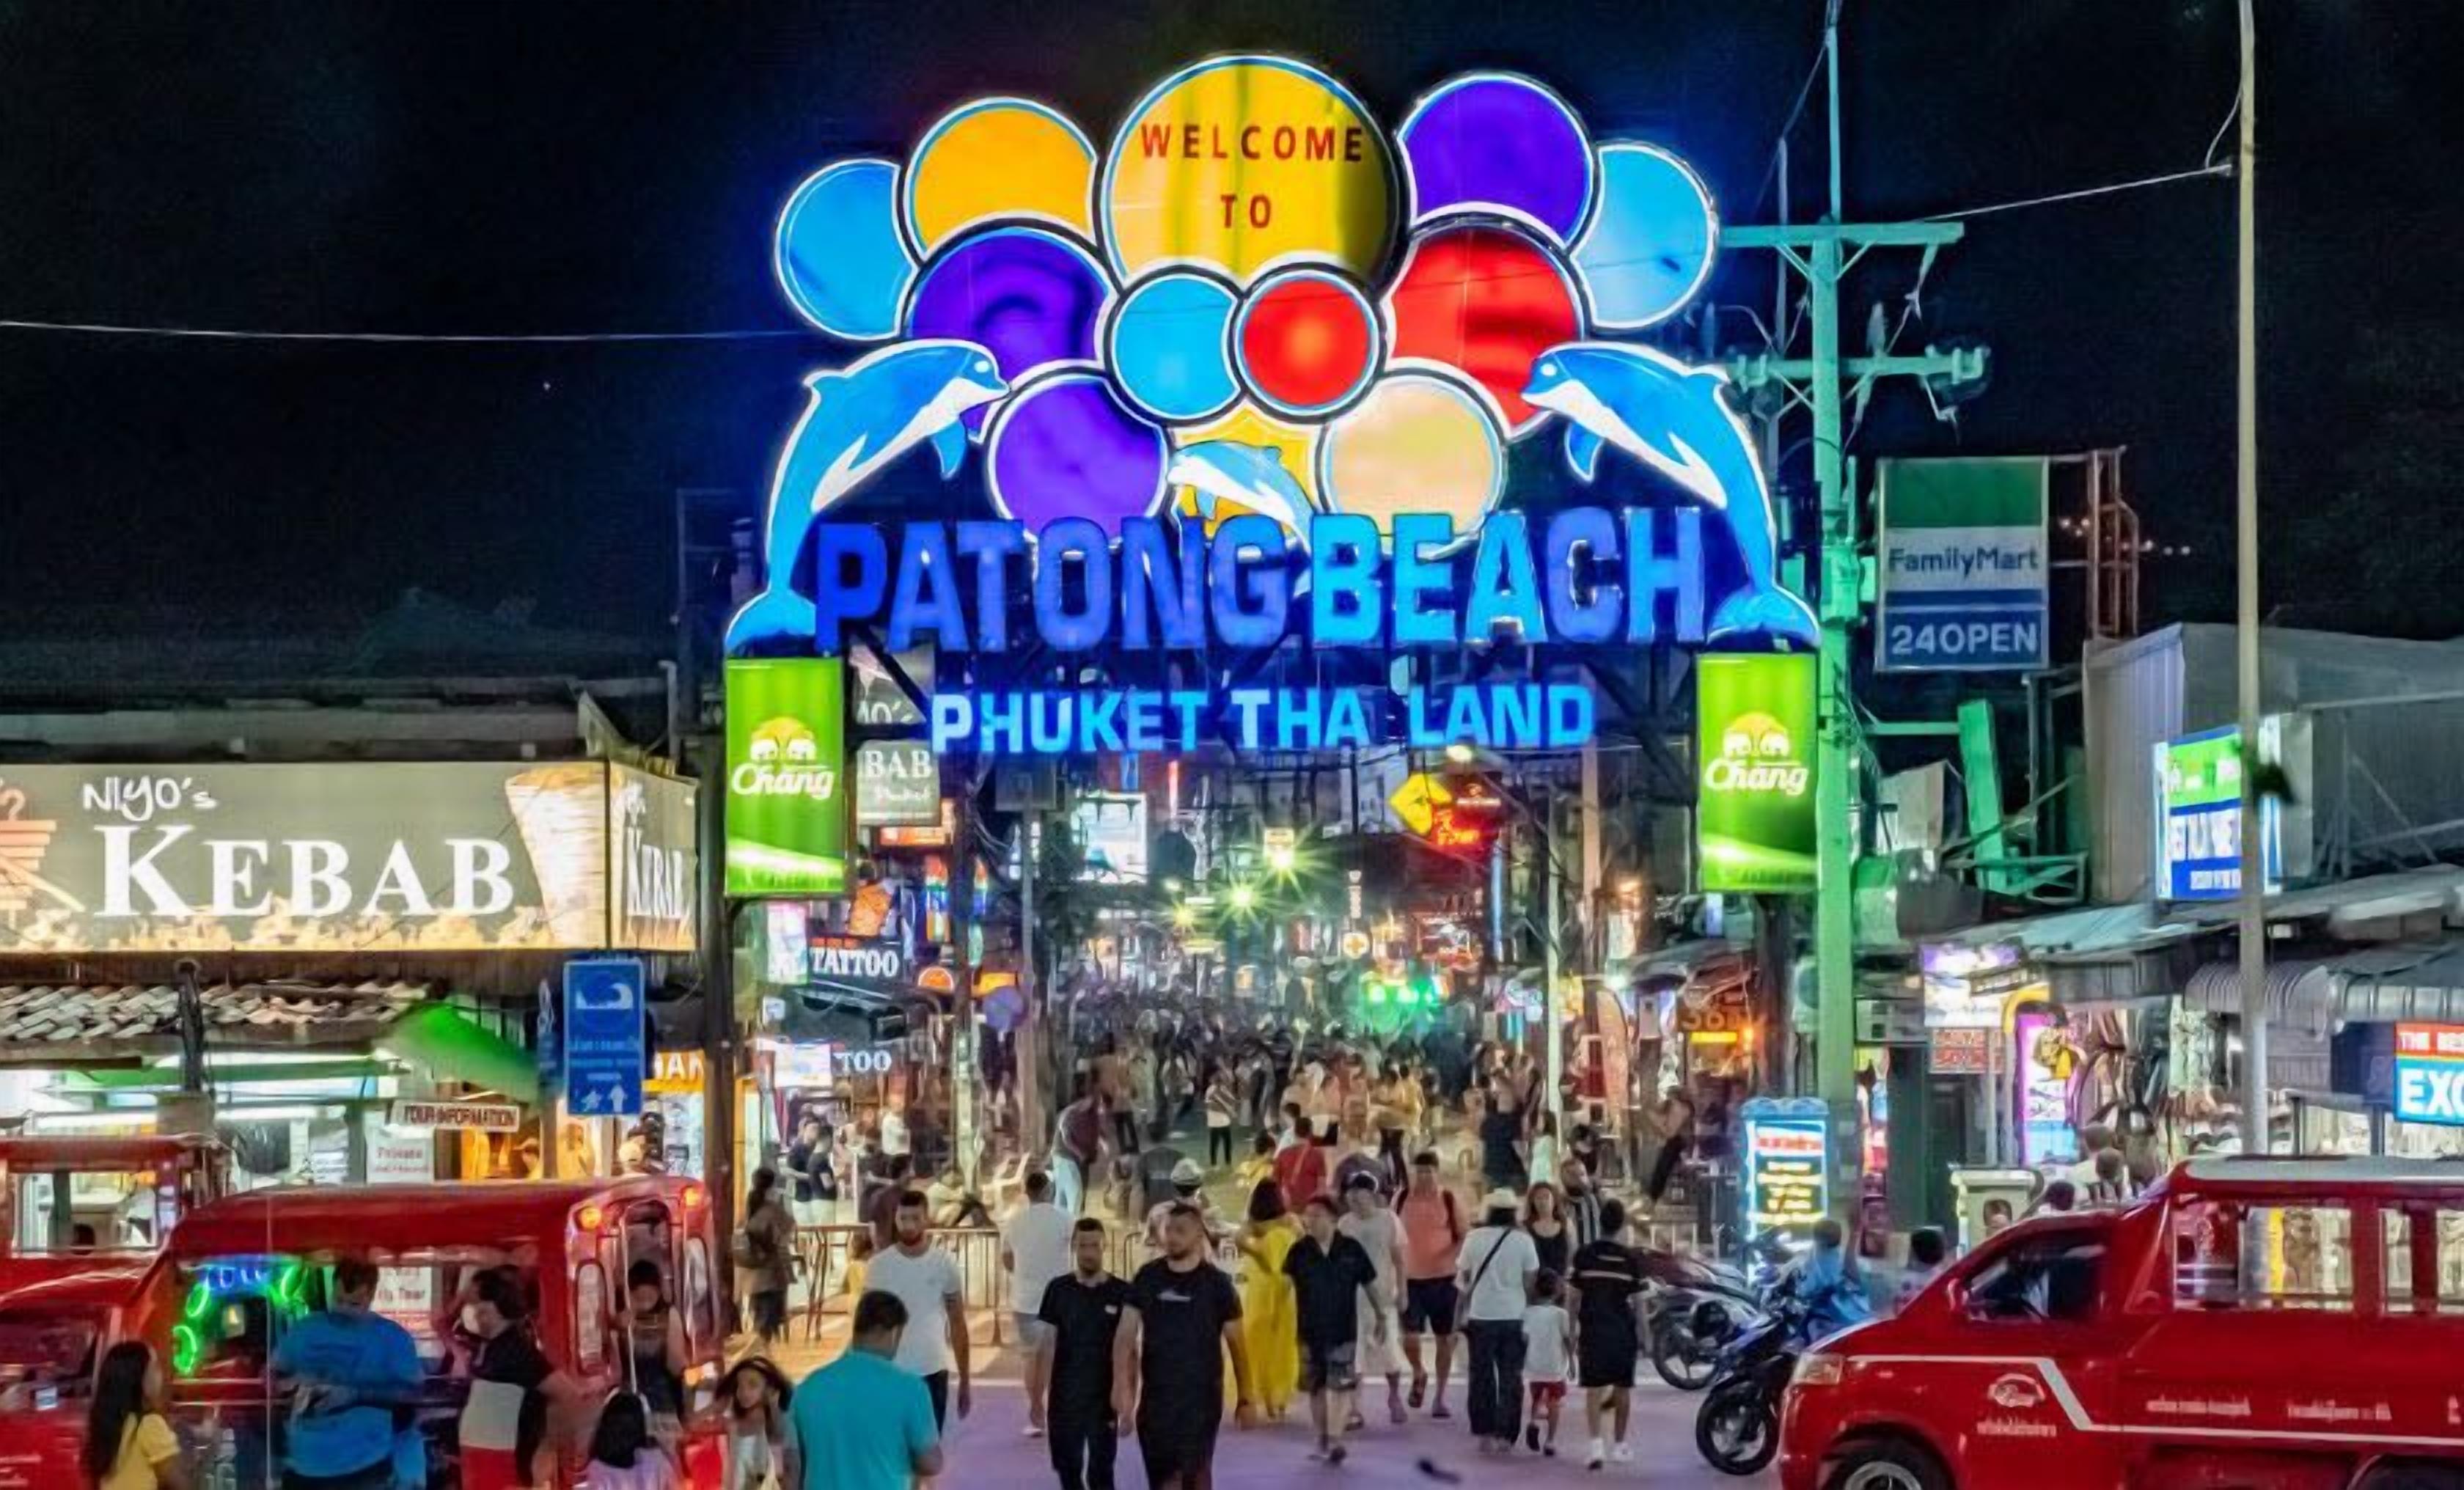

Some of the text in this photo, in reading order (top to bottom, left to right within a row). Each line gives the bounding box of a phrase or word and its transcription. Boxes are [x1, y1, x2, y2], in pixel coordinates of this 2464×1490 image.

[1141, 123, 1363, 162] WELCOME
[1220, 194, 1272, 229] TO
[814, 506, 1706, 651] PATONG BEACH
[1889, 544, 2038, 580] FamilyMart
[931, 689, 1209, 753] PHUKET
[732, 761, 835, 800] Chang
[1705, 757, 1808, 796] Chang
[92, 823, 515, 918] KEBAB
[810, 946, 900, 978] TATTOO
